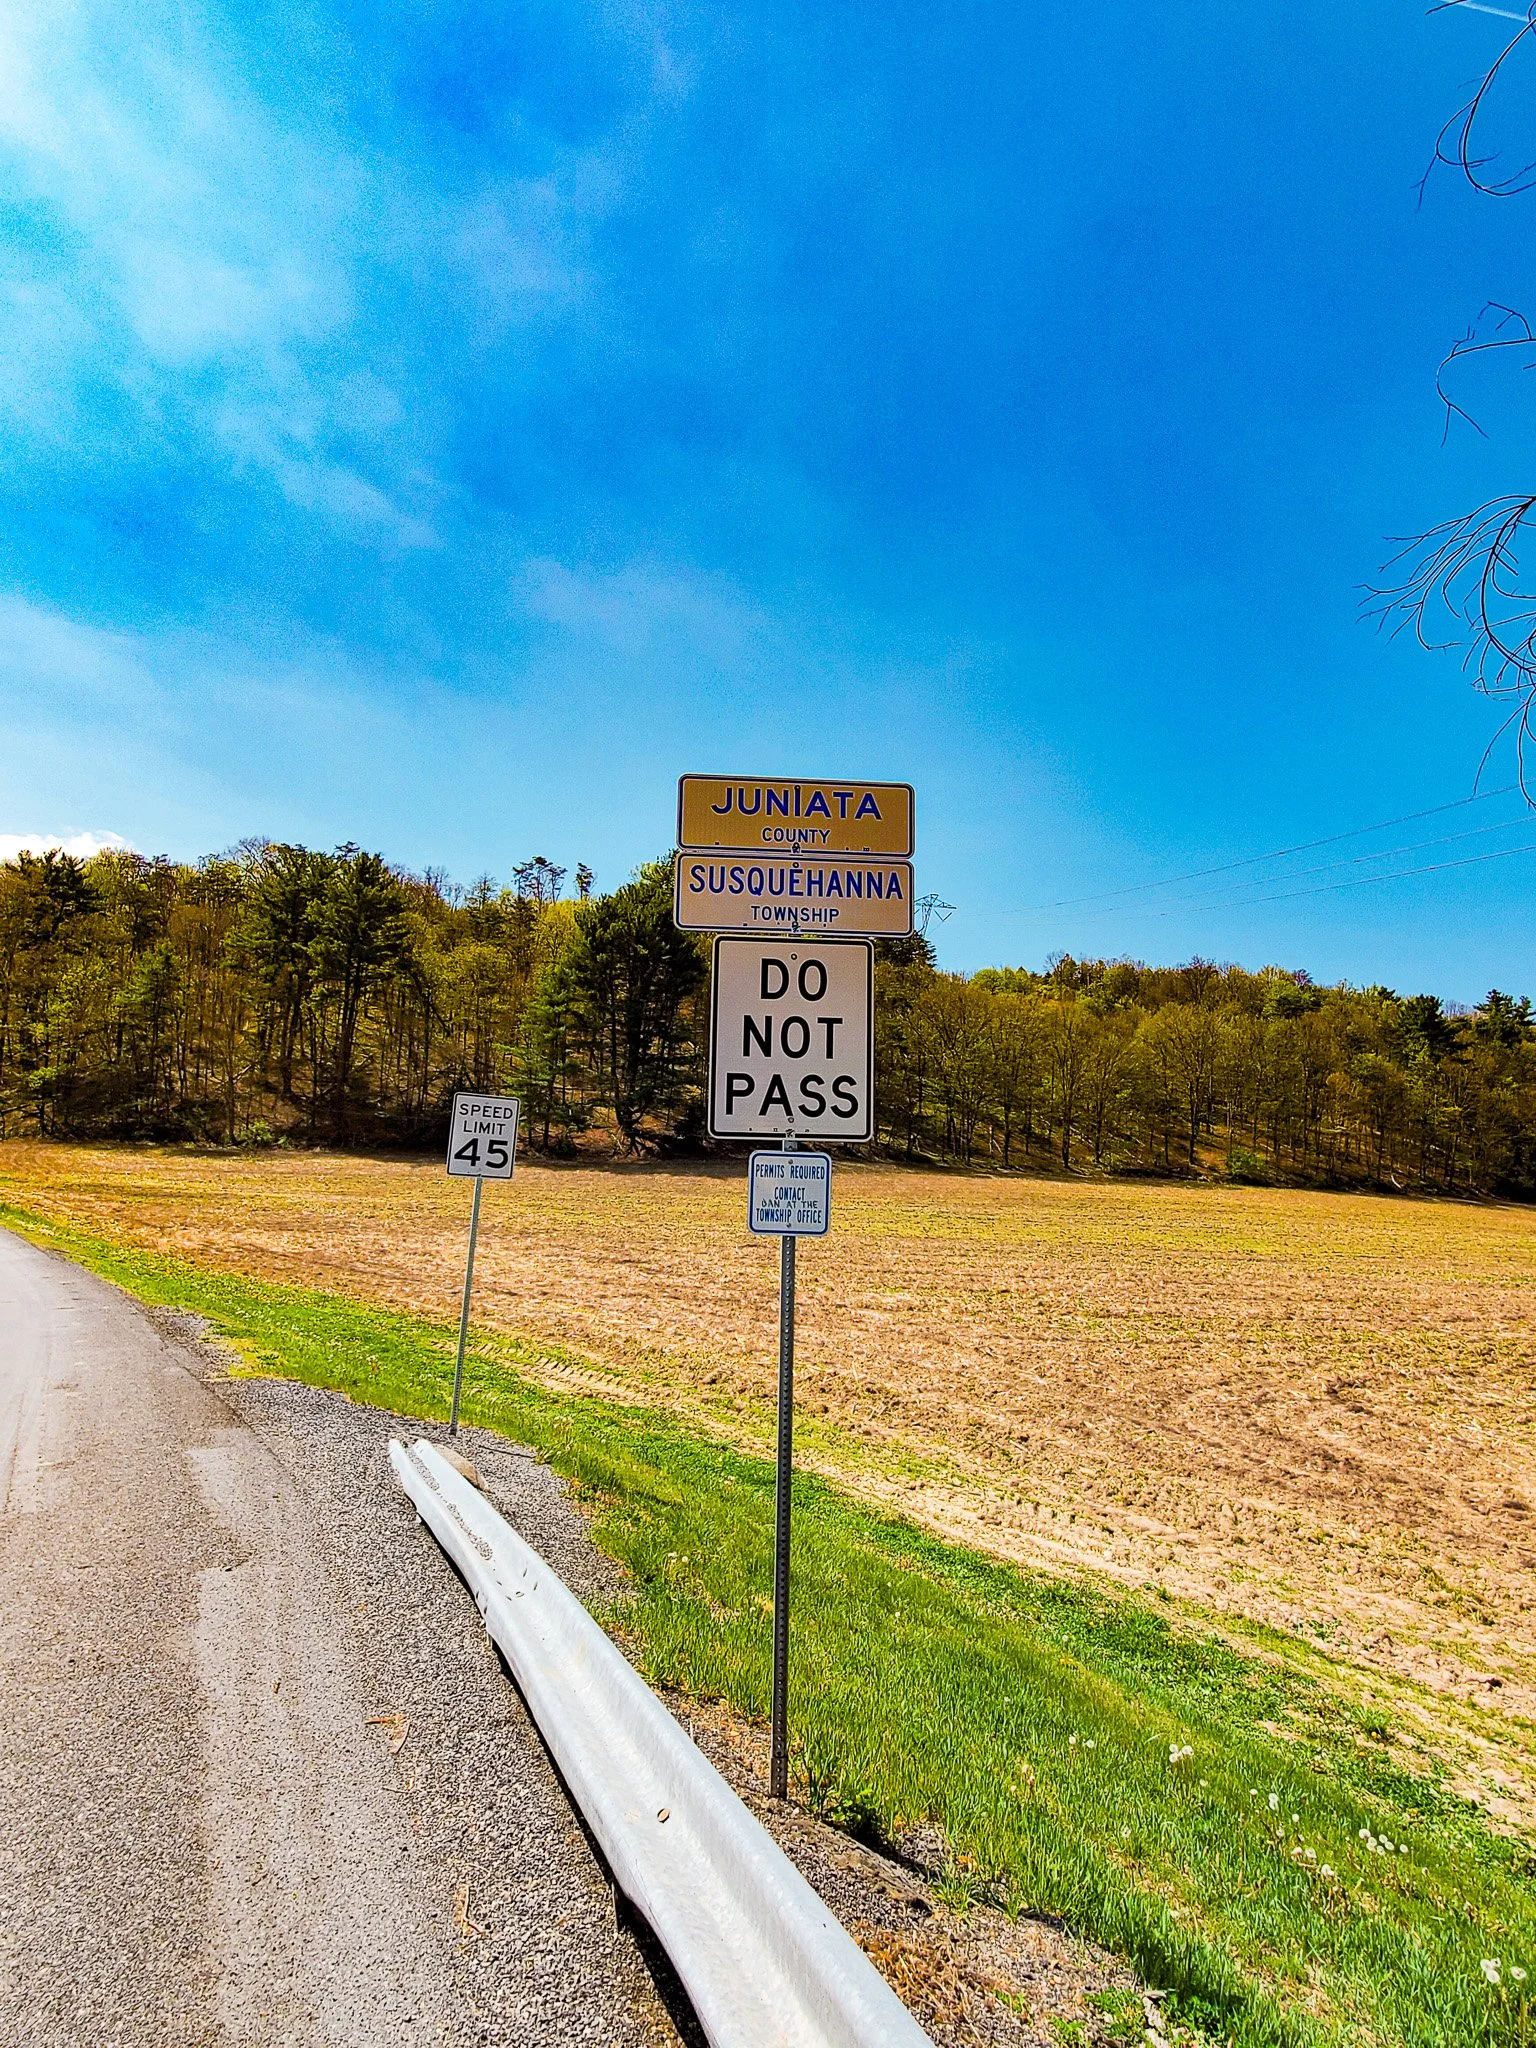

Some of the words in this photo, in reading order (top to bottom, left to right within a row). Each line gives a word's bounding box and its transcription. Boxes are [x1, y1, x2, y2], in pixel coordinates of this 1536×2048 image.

[711, 787, 882, 820] JUNIATA
[762, 827, 830, 843] COUNTY
[689, 865, 903, 900] SUSQUEHANNA
[751, 905, 839, 923] TOWNSHIP
[760, 958, 828, 1001] DO
[743, 1014, 843, 1059] NOT
[725, 1072, 858, 1118] PASS
[459, 1103, 513, 1119] SPEED
[463, 1120, 506, 1135] LIMIT
[454, 1138, 509, 1169] 45
[755, 1164, 785, 1178] PERMITS
[790, 1165, 825, 1180] REQUIRED
[774, 1187, 806, 1200] CONTACT
[761, 1198, 780, 1208] DAN
[786, 1200, 797, 1209] AT
[801, 1200, 818, 1209] THE
[755, 1208, 792, 1222] TOWNSHIP
[797, 1209, 822, 1223] OFFICE
